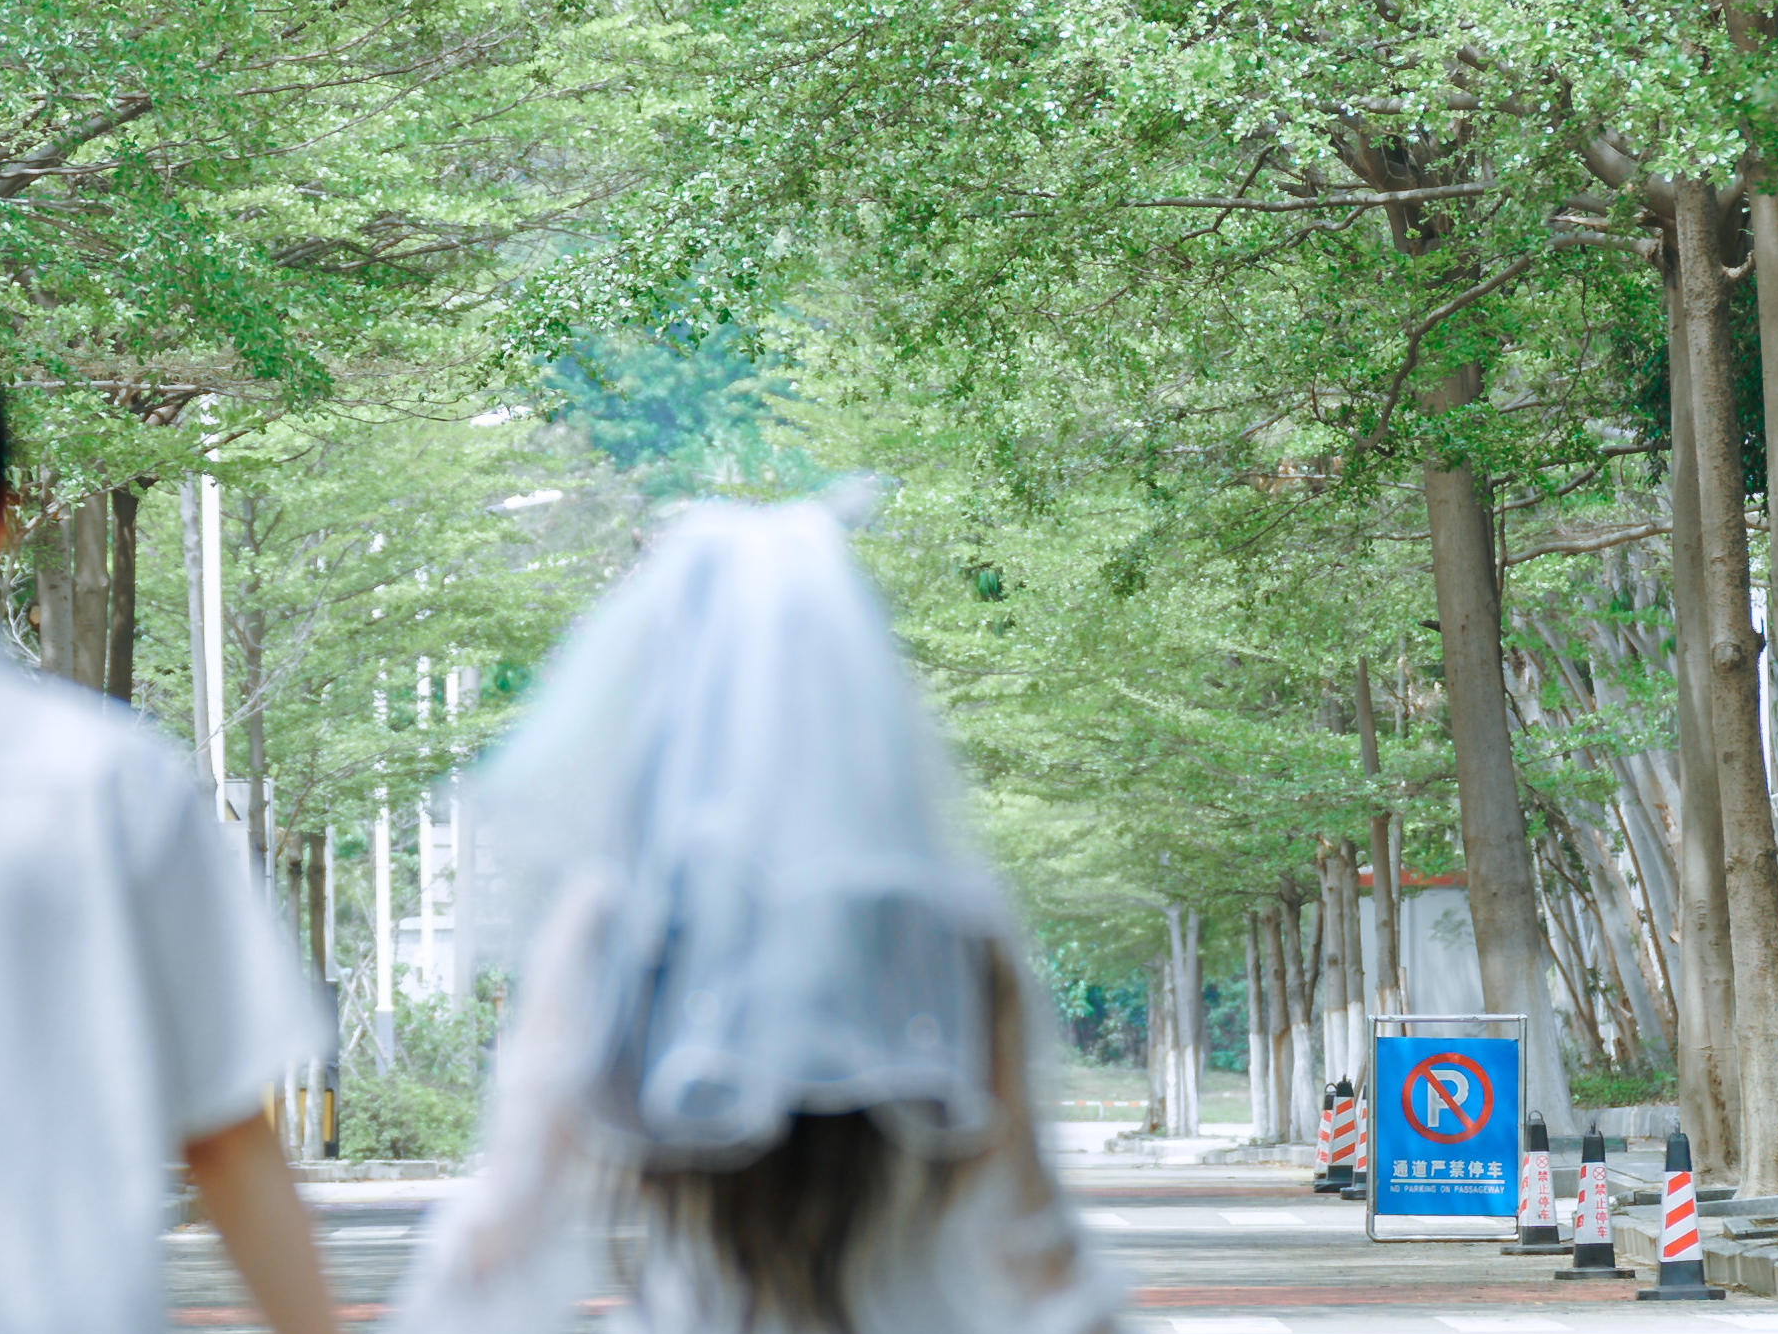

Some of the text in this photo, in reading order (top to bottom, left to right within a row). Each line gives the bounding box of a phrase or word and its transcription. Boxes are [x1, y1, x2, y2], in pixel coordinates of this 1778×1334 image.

[1392, 1159, 1503, 1178] 通道严禁停车
[1389, 1185, 1505, 1194] NO PARKING ON PASSAGEWAY
[1537, 1170, 1550, 1220] 禁止停车
[1595, 1183, 1608, 1238] 禁止停车
